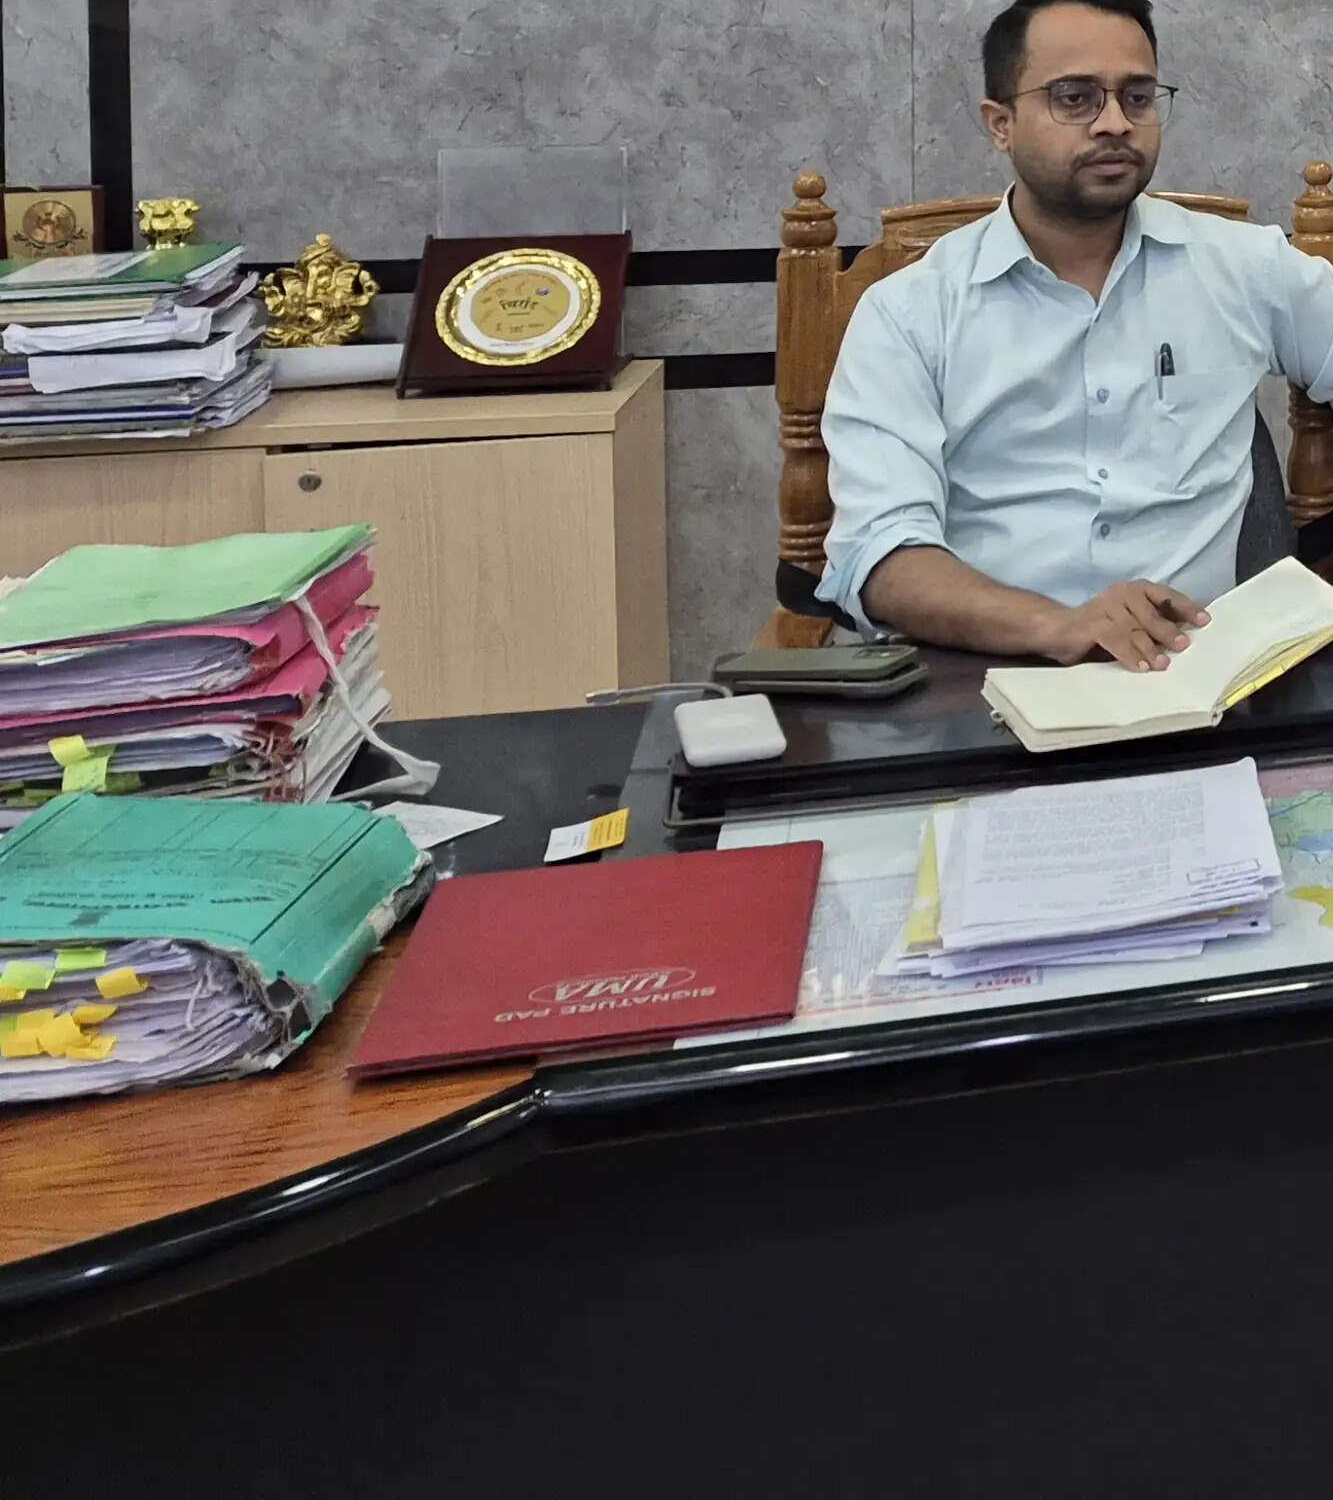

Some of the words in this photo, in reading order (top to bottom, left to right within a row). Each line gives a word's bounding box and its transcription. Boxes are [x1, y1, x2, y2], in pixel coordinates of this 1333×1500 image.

[555, 974, 668, 1001] UMA
[560, 986, 717, 1016] SIGNATURE
[494, 1007, 551, 1024] PAD
